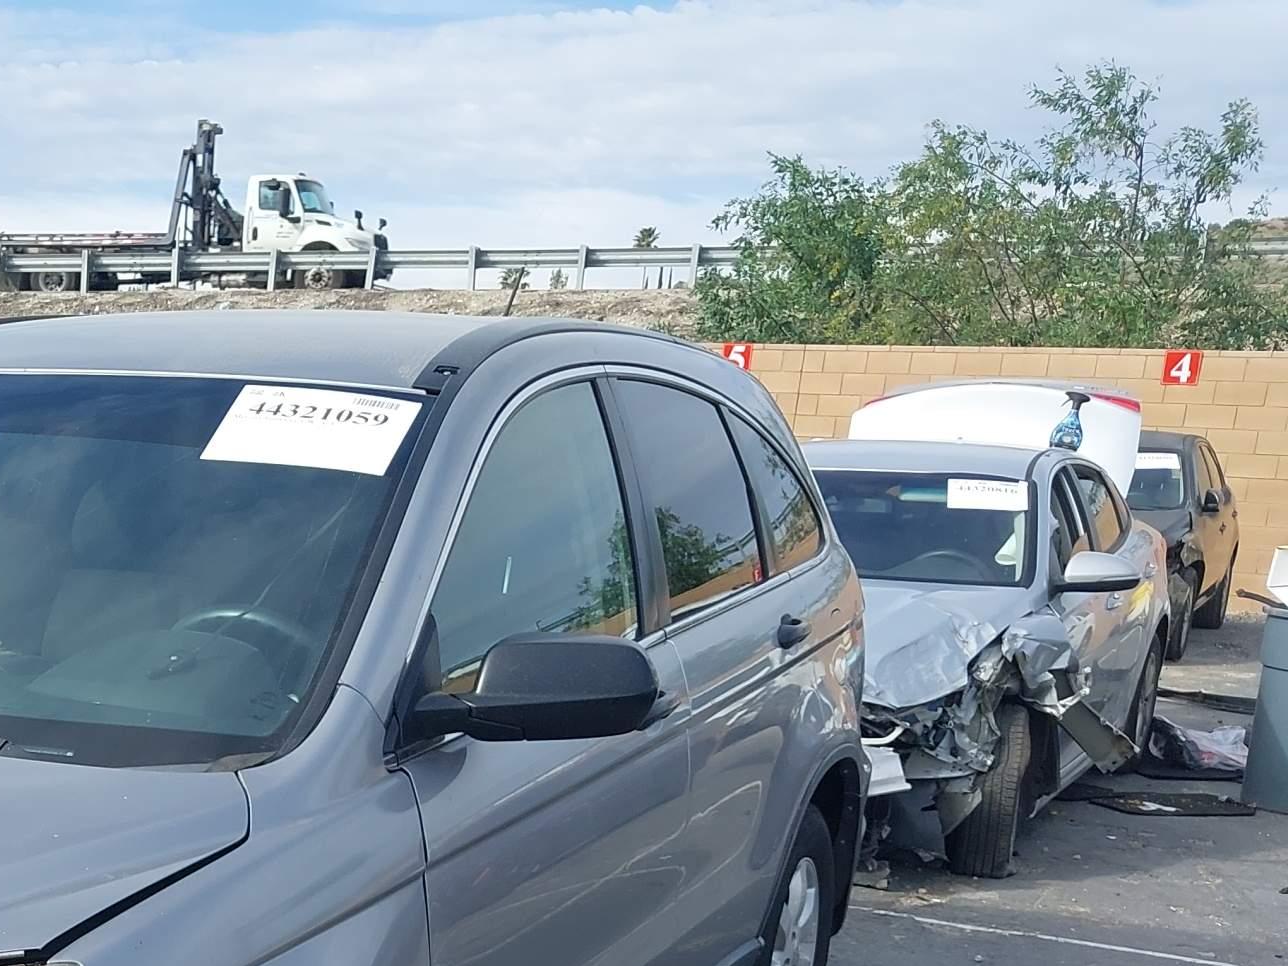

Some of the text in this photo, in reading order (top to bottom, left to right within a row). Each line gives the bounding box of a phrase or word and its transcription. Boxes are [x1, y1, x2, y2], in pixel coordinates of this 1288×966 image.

[728, 344, 746, 369] 5
[1169, 352, 1192, 384] 4
[249, 401, 389, 426] 44321059
